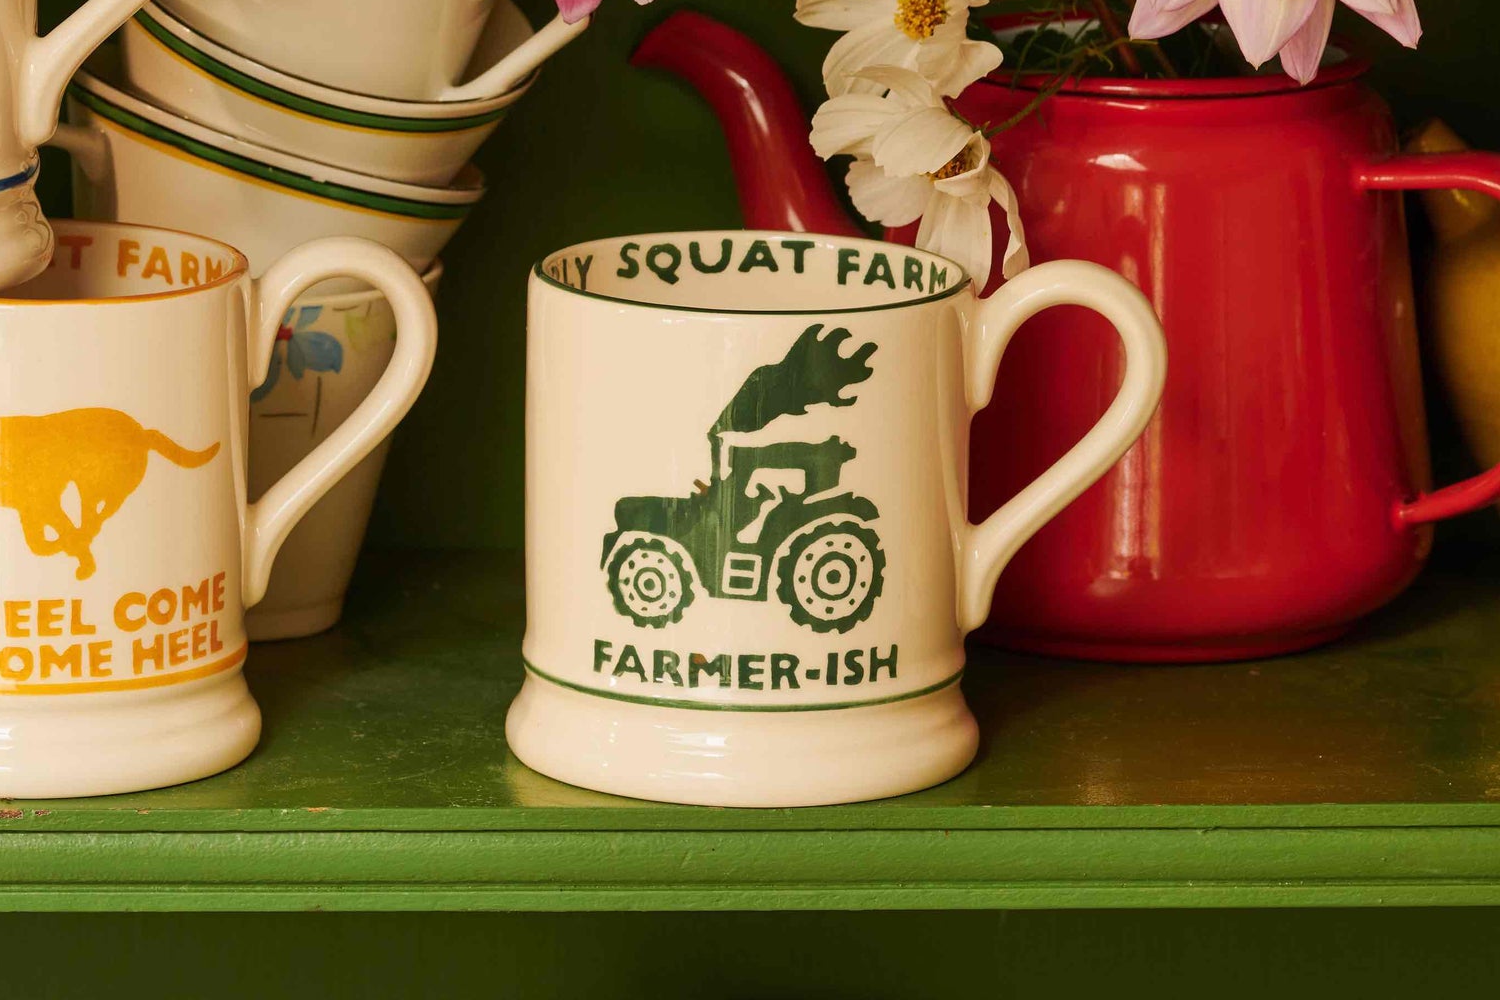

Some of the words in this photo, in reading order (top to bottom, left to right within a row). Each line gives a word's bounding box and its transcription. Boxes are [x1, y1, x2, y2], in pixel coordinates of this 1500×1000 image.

[117, 239, 224, 285] FARM
[616, 238, 815, 285] SQUAT
[837, 247, 948, 294] FARM
[113, 571, 226, 633] COME
[132, 619, 224, 676] HEEL
[593, 638, 899, 691] FARMER-ISH
